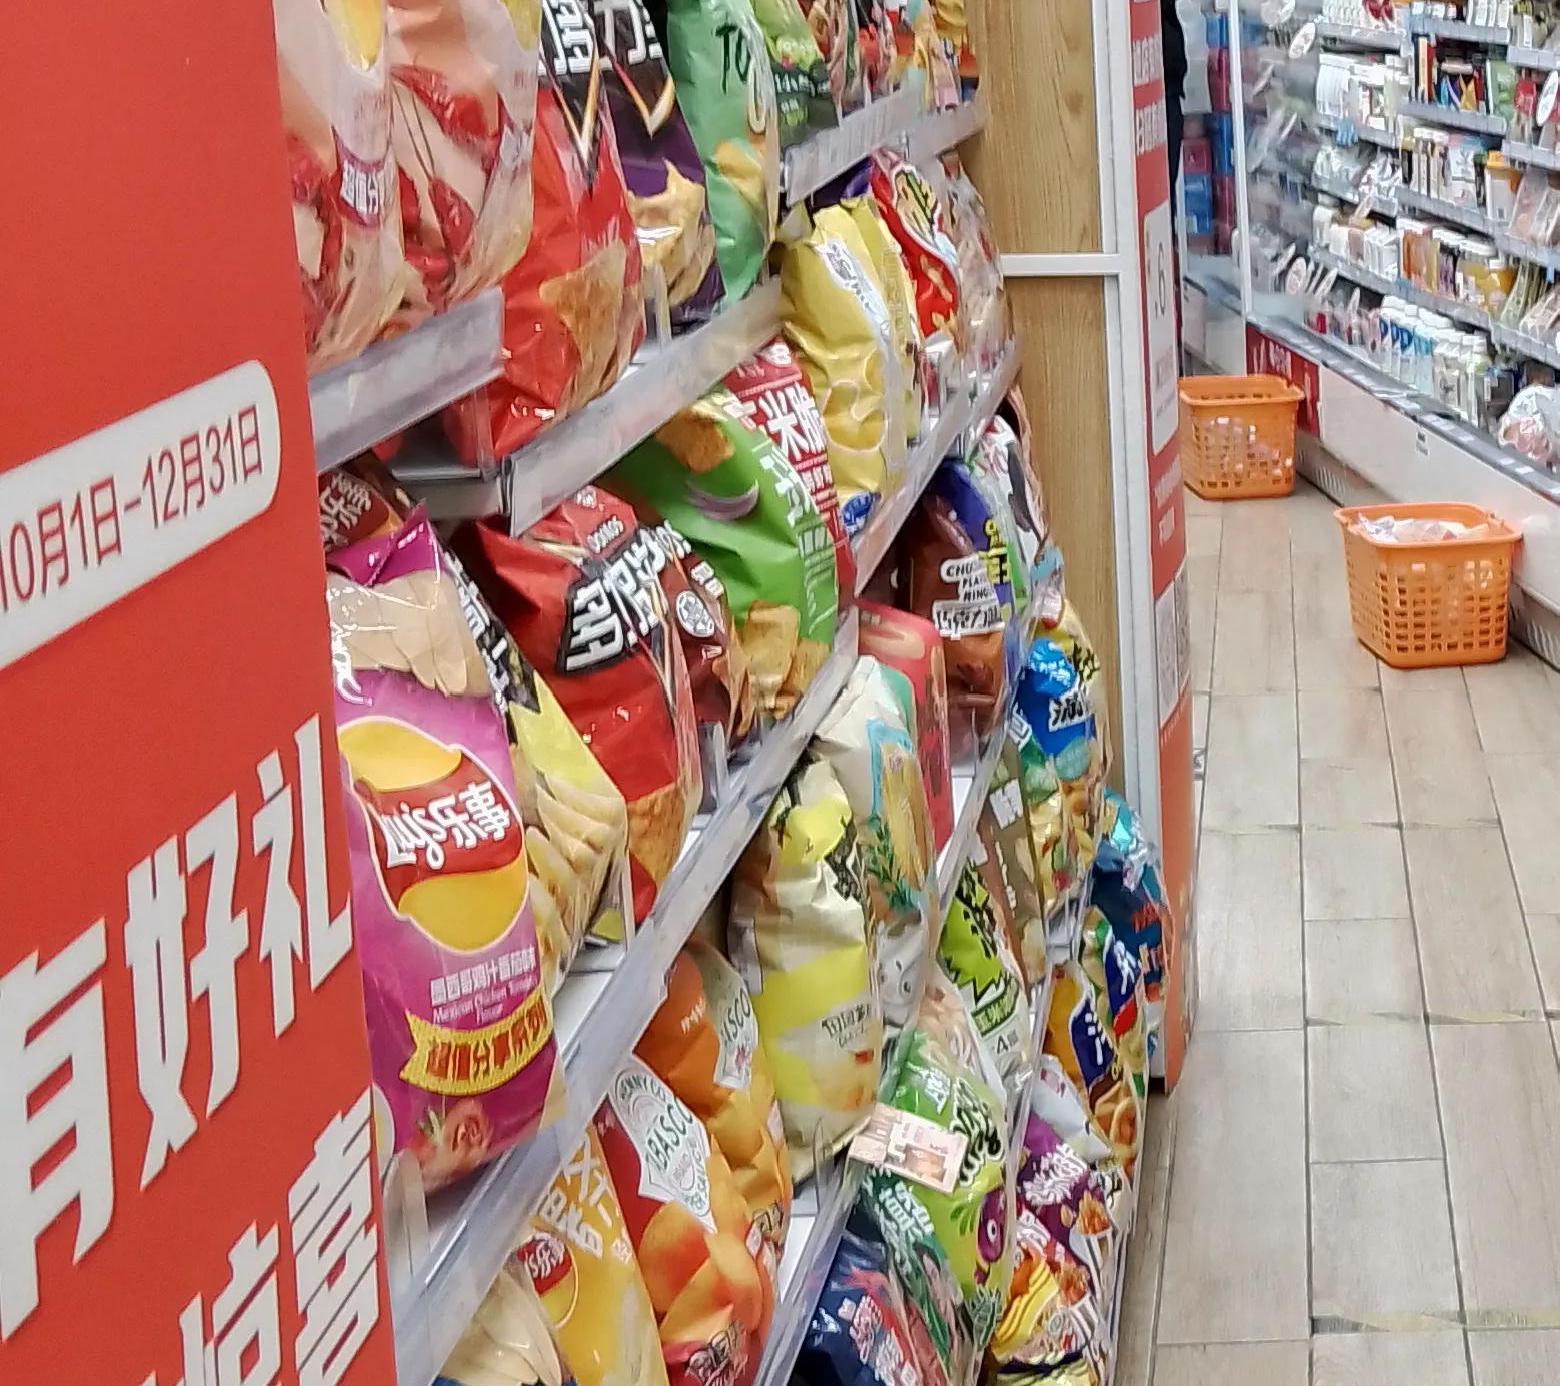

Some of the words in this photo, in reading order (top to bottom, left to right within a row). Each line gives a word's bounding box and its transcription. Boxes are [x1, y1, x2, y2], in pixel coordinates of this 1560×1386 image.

[385, 800, 447, 869] Lay's
[435, 782, 511, 850] 乐事
[0, 713, 353, 1341] 有好礼
